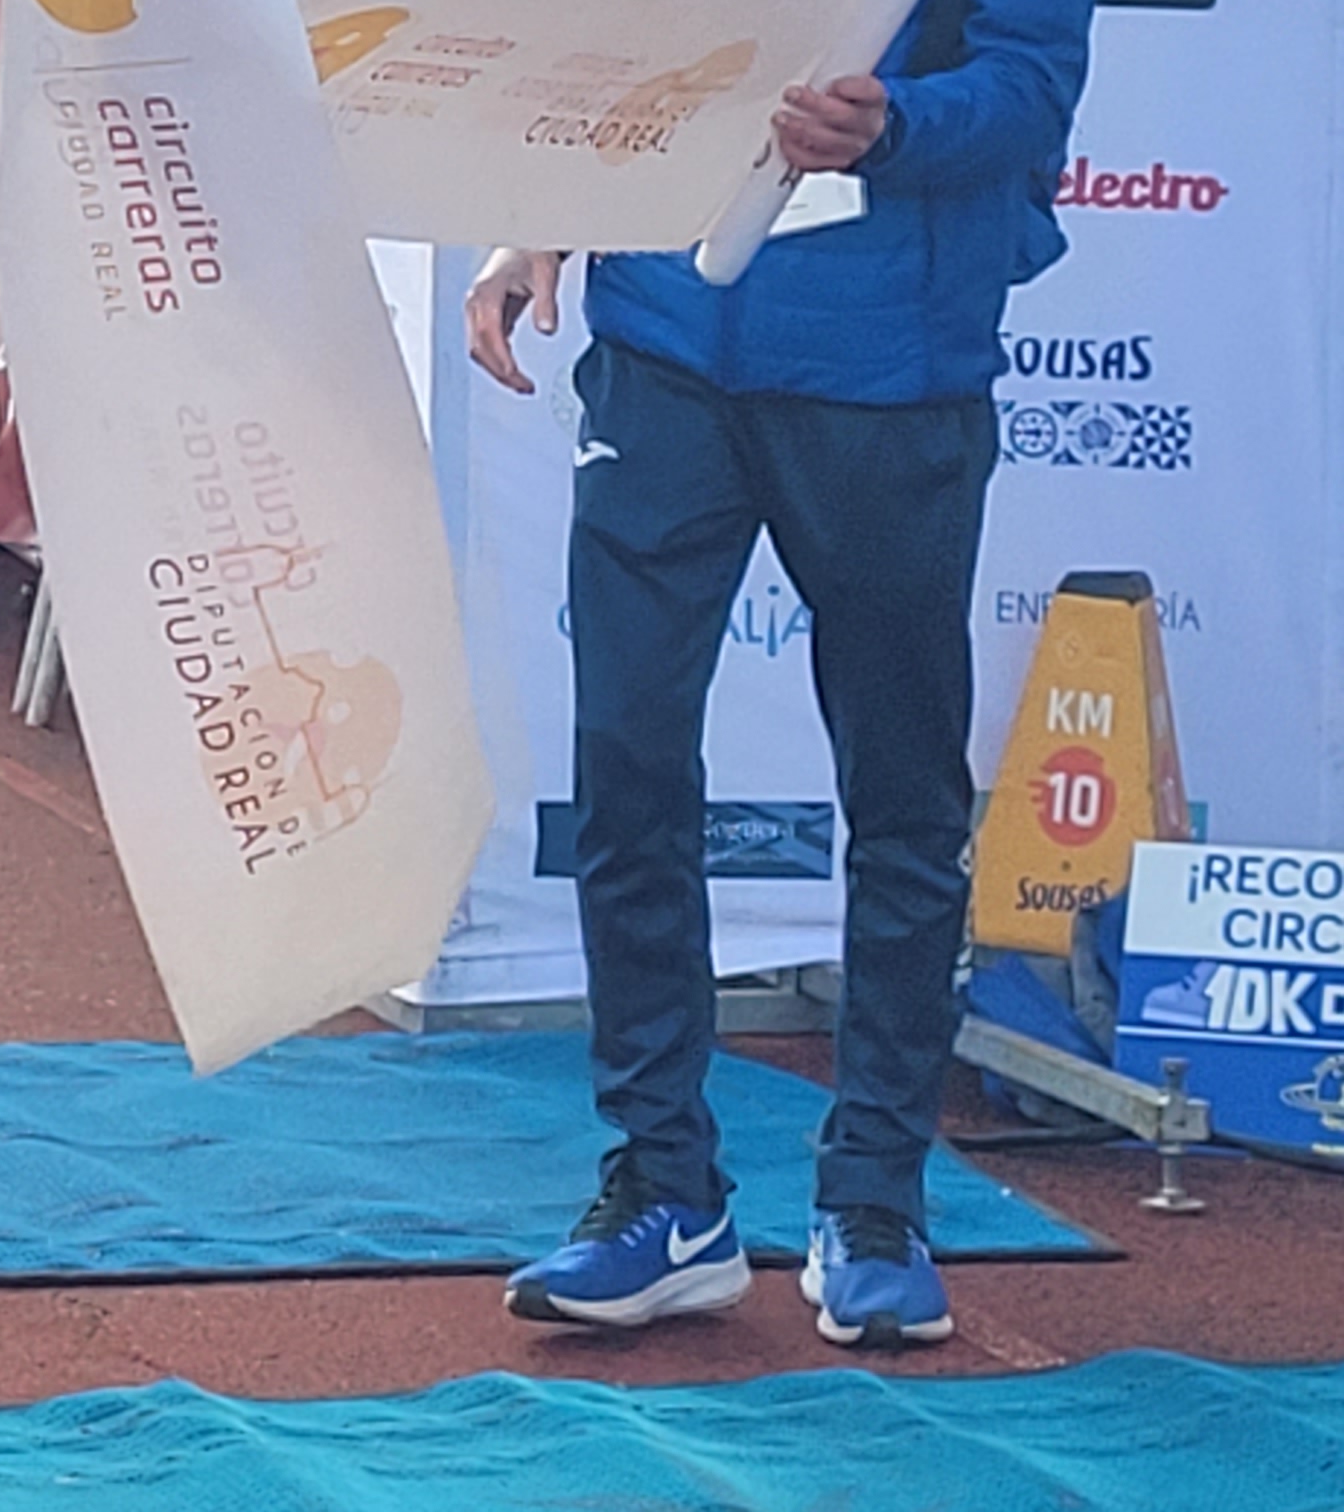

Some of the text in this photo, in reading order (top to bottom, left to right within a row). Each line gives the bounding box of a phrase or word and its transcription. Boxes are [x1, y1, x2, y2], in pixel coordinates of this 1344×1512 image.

[98, 99, 180, 313] carreras
[144, 96, 222, 284] circuito
[996, 333, 1154, 380] OUSAS
[149, 557, 277, 875] CIUDAD REAL
[186, 552, 308, 857] DIPUTACION DE
[1046, 687, 1114, 738] KM
[1047, 771, 1102, 828] 10
